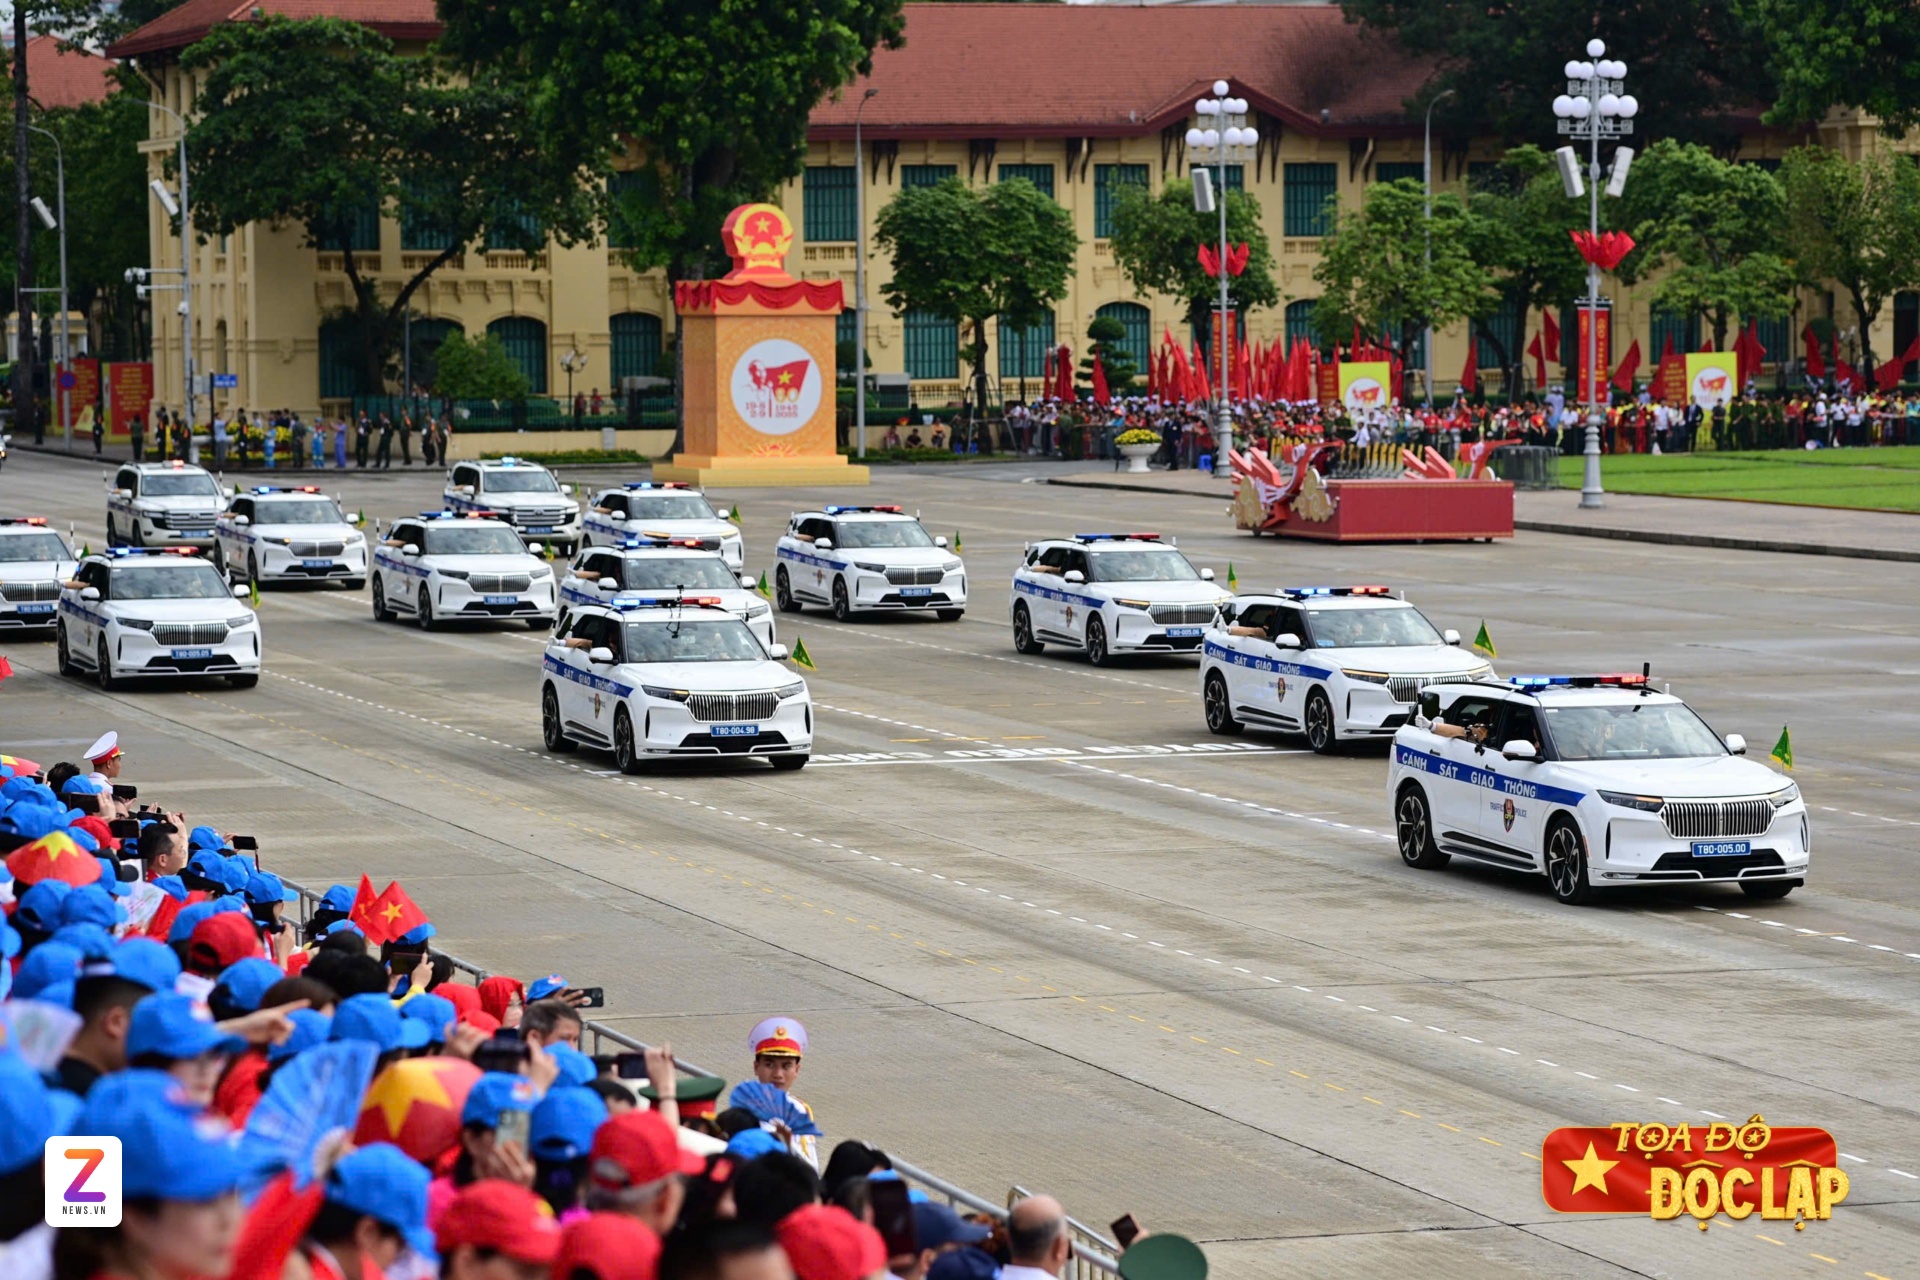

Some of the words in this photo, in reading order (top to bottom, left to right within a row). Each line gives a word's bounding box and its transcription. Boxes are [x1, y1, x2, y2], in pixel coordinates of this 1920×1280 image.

[1439, 762, 1458, 779] SÁT
[1470, 771, 1495, 788] GIAO
[1504, 779, 1537, 798] THÔNG
